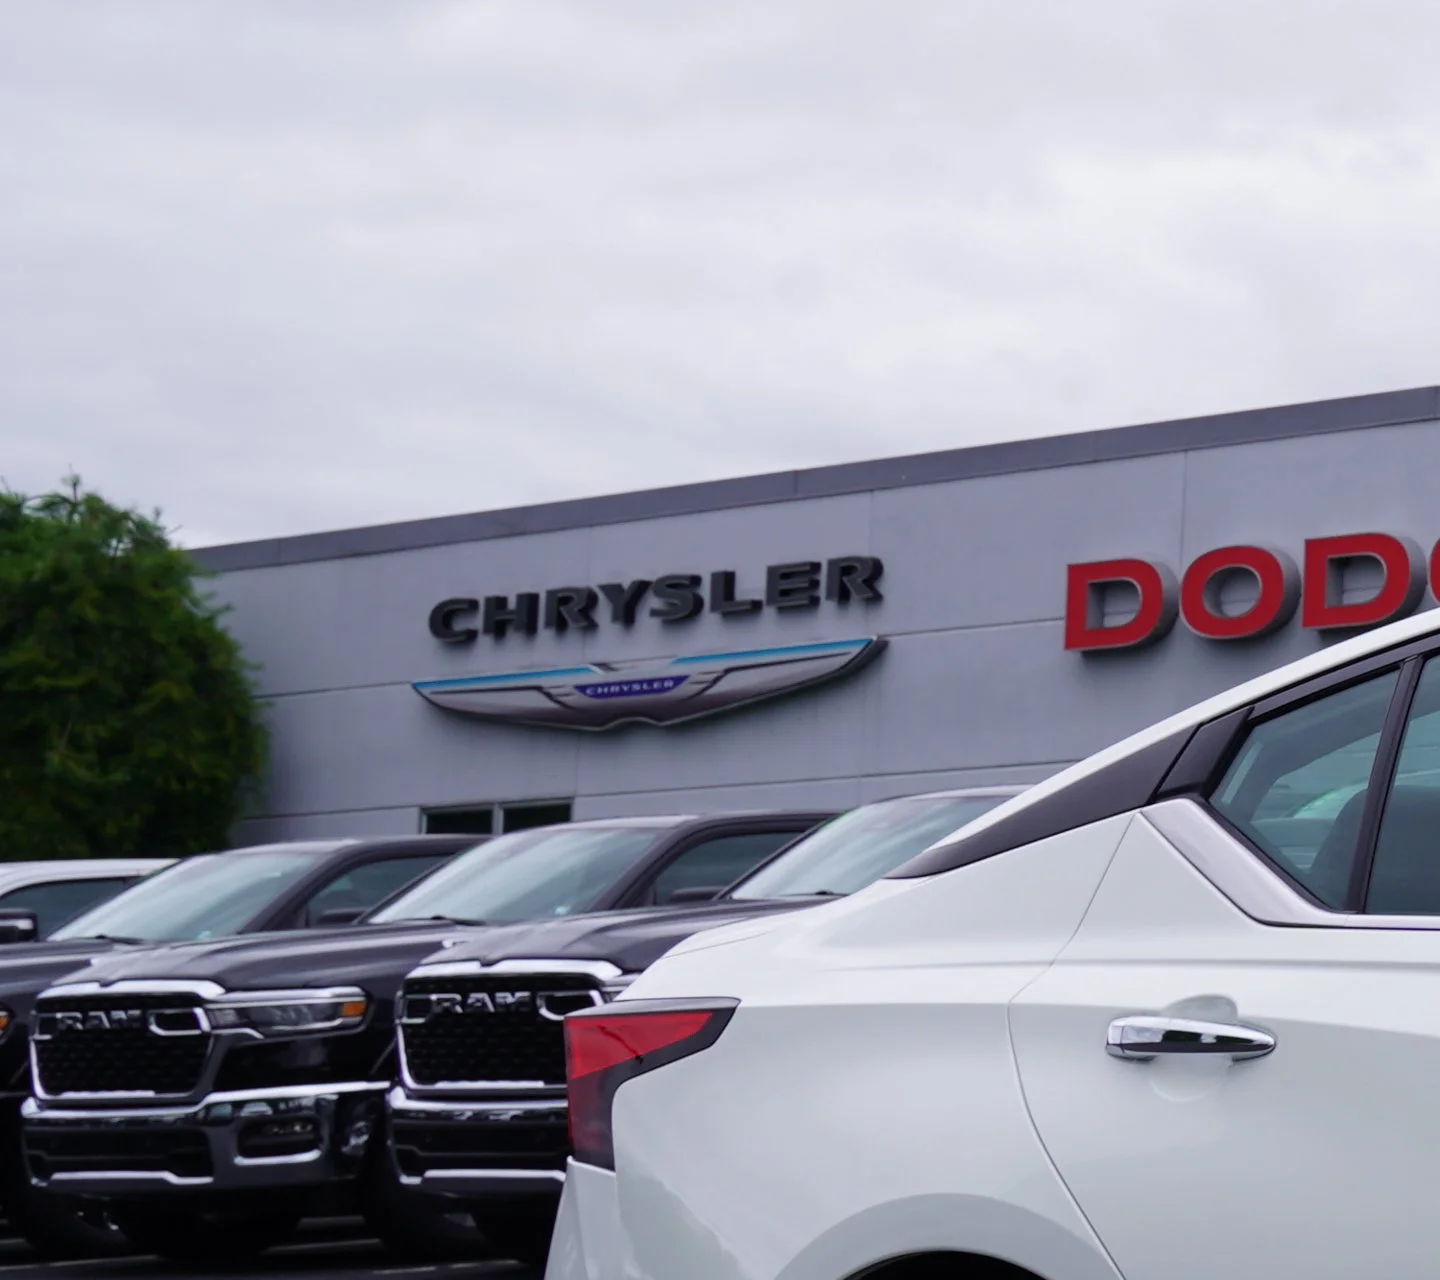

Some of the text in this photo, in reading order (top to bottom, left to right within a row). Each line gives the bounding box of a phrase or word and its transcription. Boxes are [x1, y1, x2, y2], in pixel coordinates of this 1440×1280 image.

[428, 555, 884, 643] CHRYSLER
[585, 679, 675, 696] CHRYSLER
[429, 991, 532, 1014] RAM
